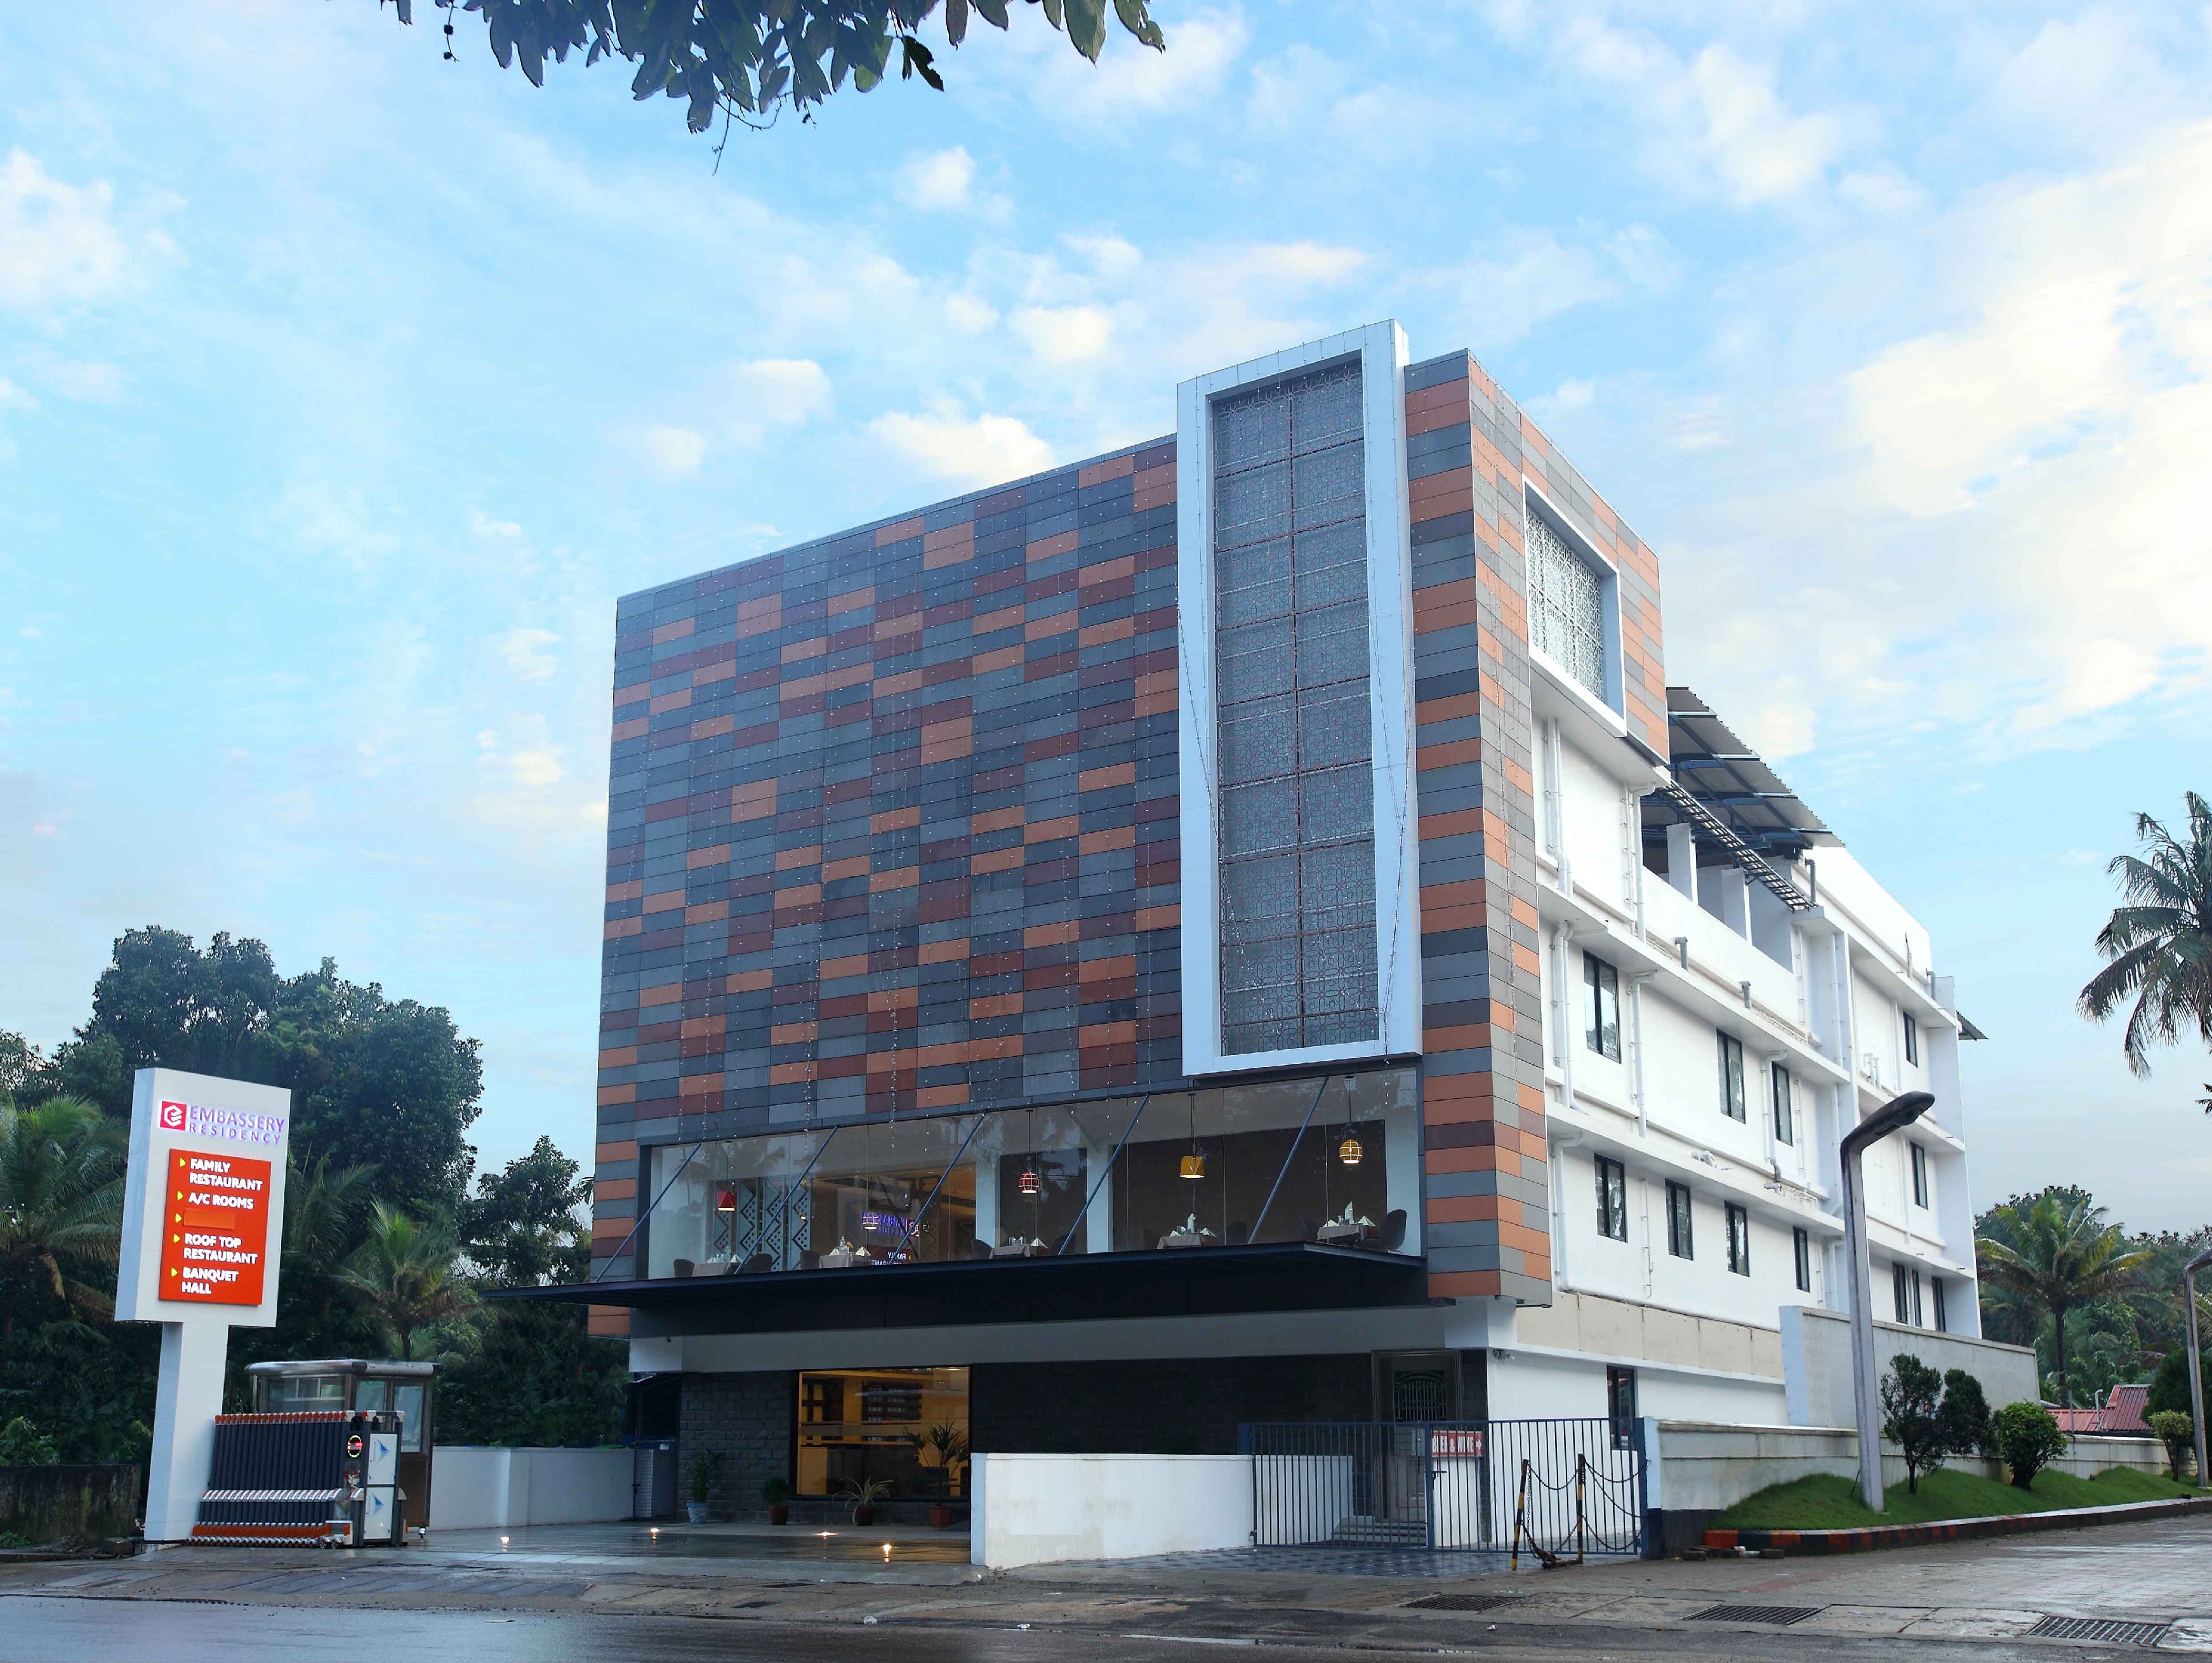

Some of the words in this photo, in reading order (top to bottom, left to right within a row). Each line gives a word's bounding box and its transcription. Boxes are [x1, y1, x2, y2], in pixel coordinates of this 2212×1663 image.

[190, 1105, 285, 1132] EMBASSERY
[189, 1123, 281, 1144] RESIDENCY
[190, 1158, 231, 1173] FAMILY
[189, 1172, 263, 1191] RESTAURANT
[189, 1192, 210, 1205] A/C
[212, 1194, 254, 1209] ROOMS
[185, 1233, 217, 1246] ROOF
[219, 1236, 242, 1249] TOP
[183, 1247, 258, 1264] RESTAURANT
[183, 1267, 239, 1283] BANQUET
[182, 1281, 212, 1294] HALL
[1450, 1438, 1455, 1452] &
[1457, 1436, 1474, 1453] WINE
